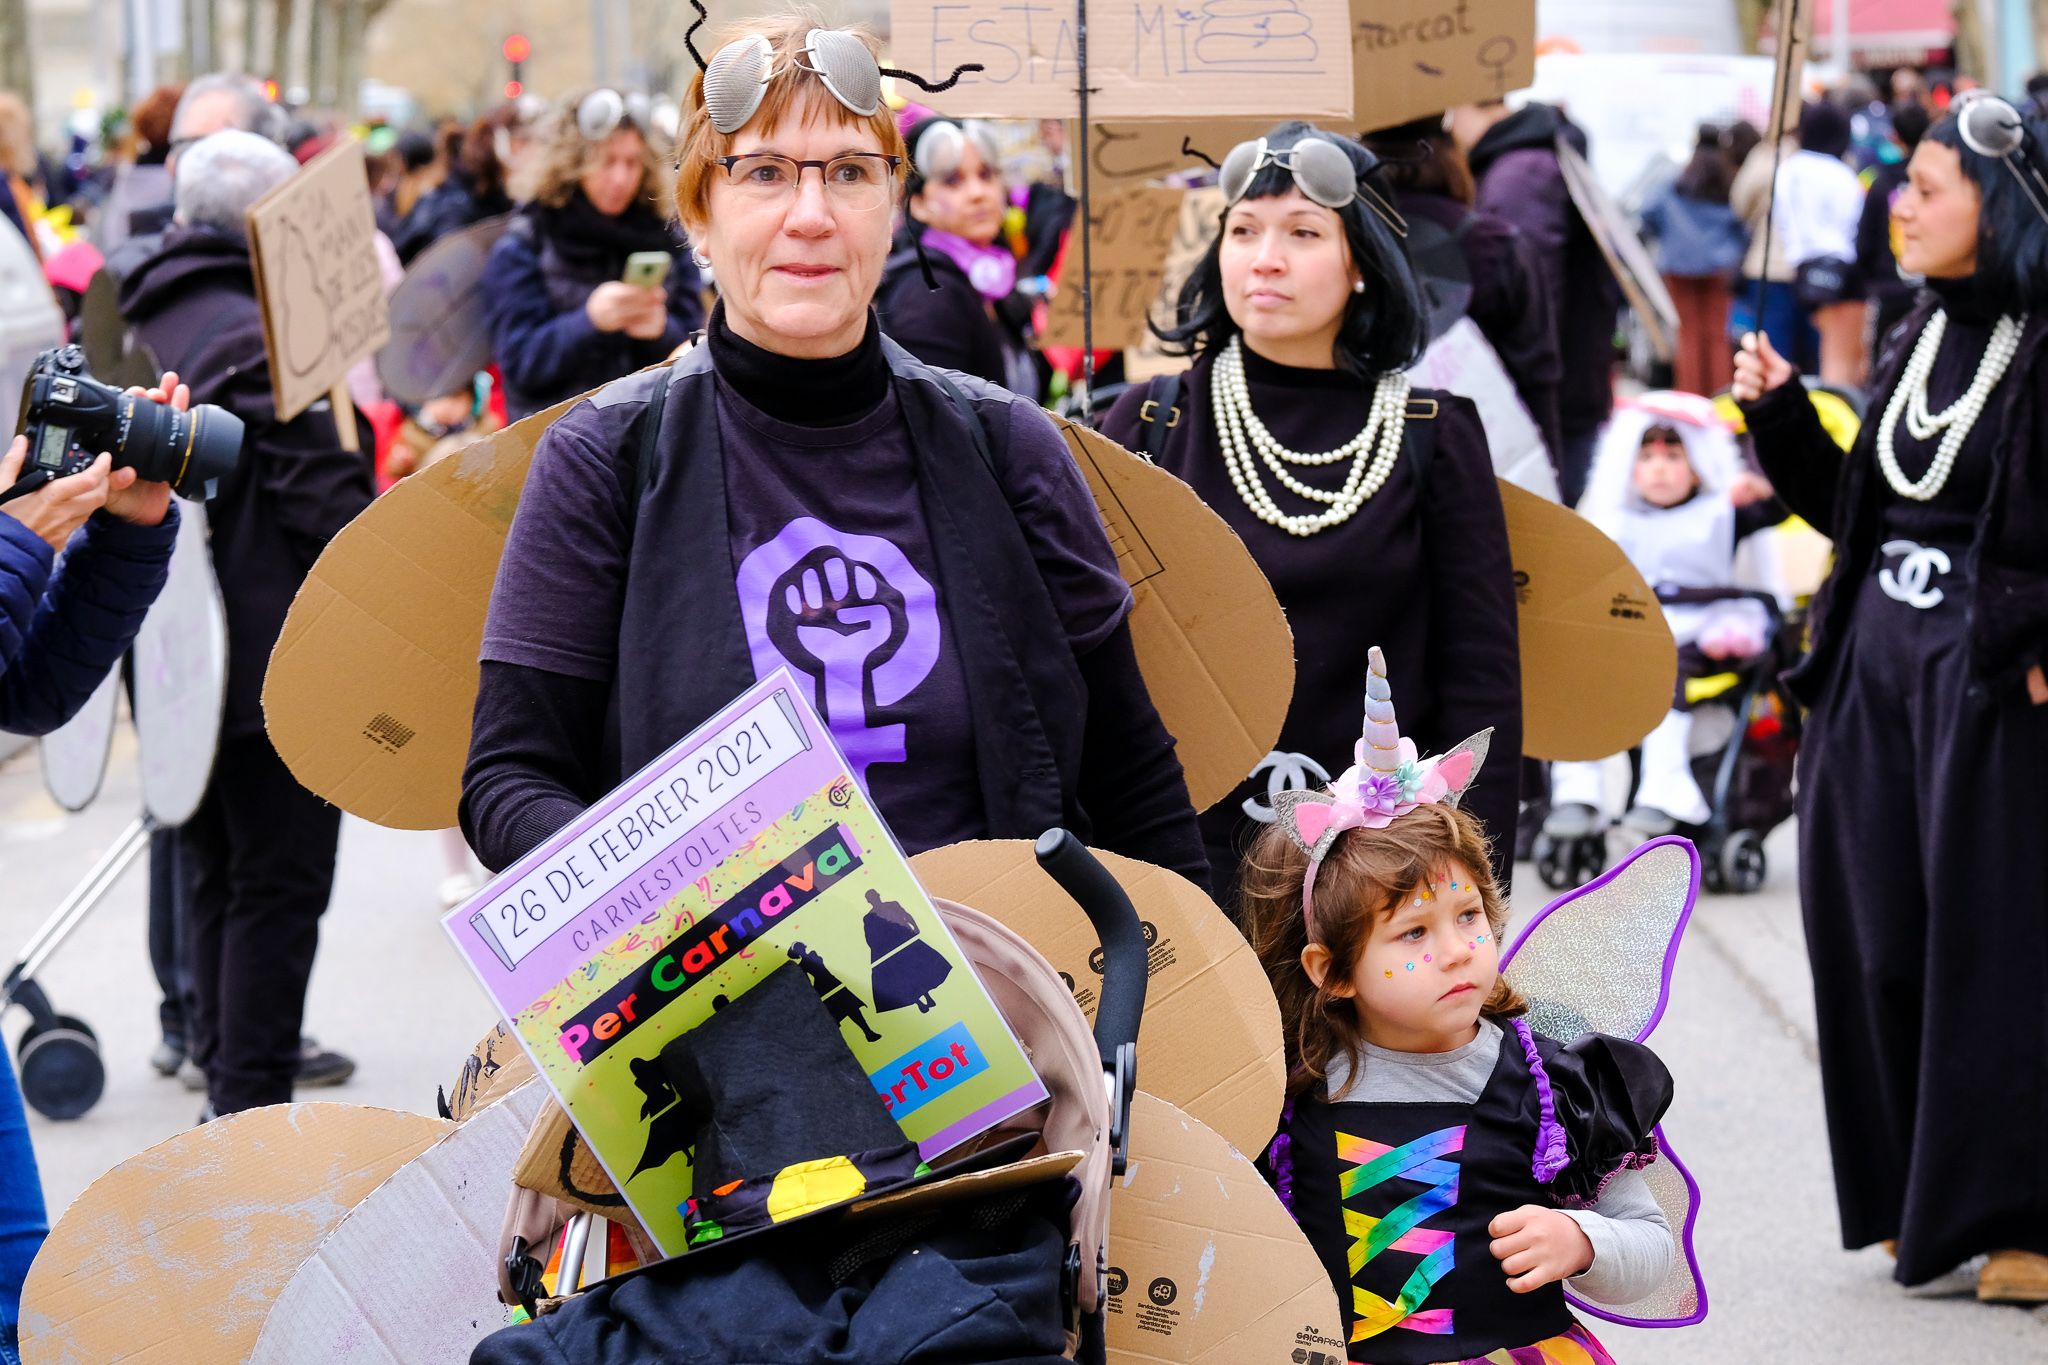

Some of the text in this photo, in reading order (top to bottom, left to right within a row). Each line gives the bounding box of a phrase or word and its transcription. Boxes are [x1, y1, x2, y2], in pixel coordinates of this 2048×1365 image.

[501, 721, 772, 938] 26 DE FEBRER 2021
[572, 801, 762, 952] CARNESTOLTES
[558, 822, 864, 1064] Per Carnaval
[881, 1042, 969, 1111] rTot
